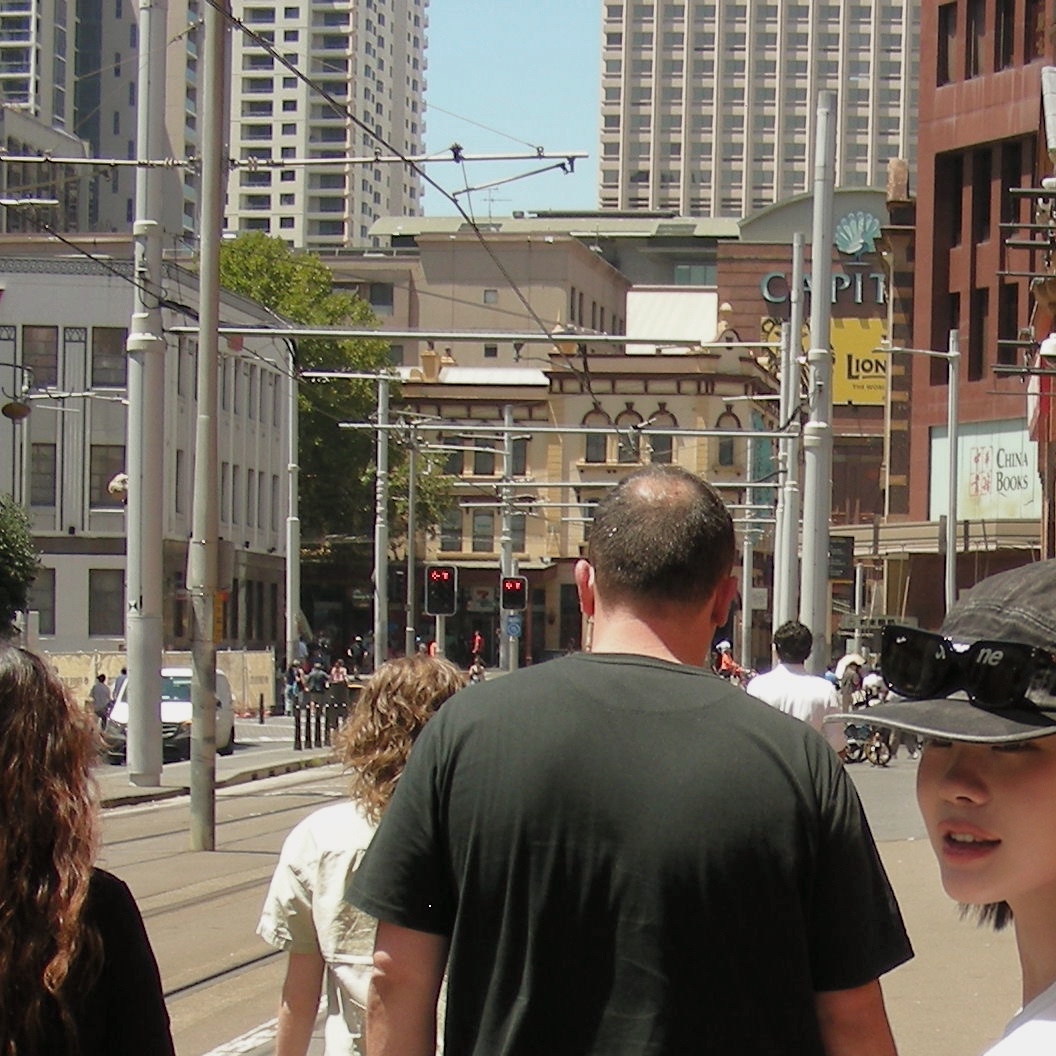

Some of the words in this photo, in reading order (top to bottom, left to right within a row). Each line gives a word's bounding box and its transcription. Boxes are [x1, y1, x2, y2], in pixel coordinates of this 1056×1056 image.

[847, 354, 886, 379] LION
[996, 448, 1028, 469] CHINA
[996, 471, 1028, 491] BOOKS
